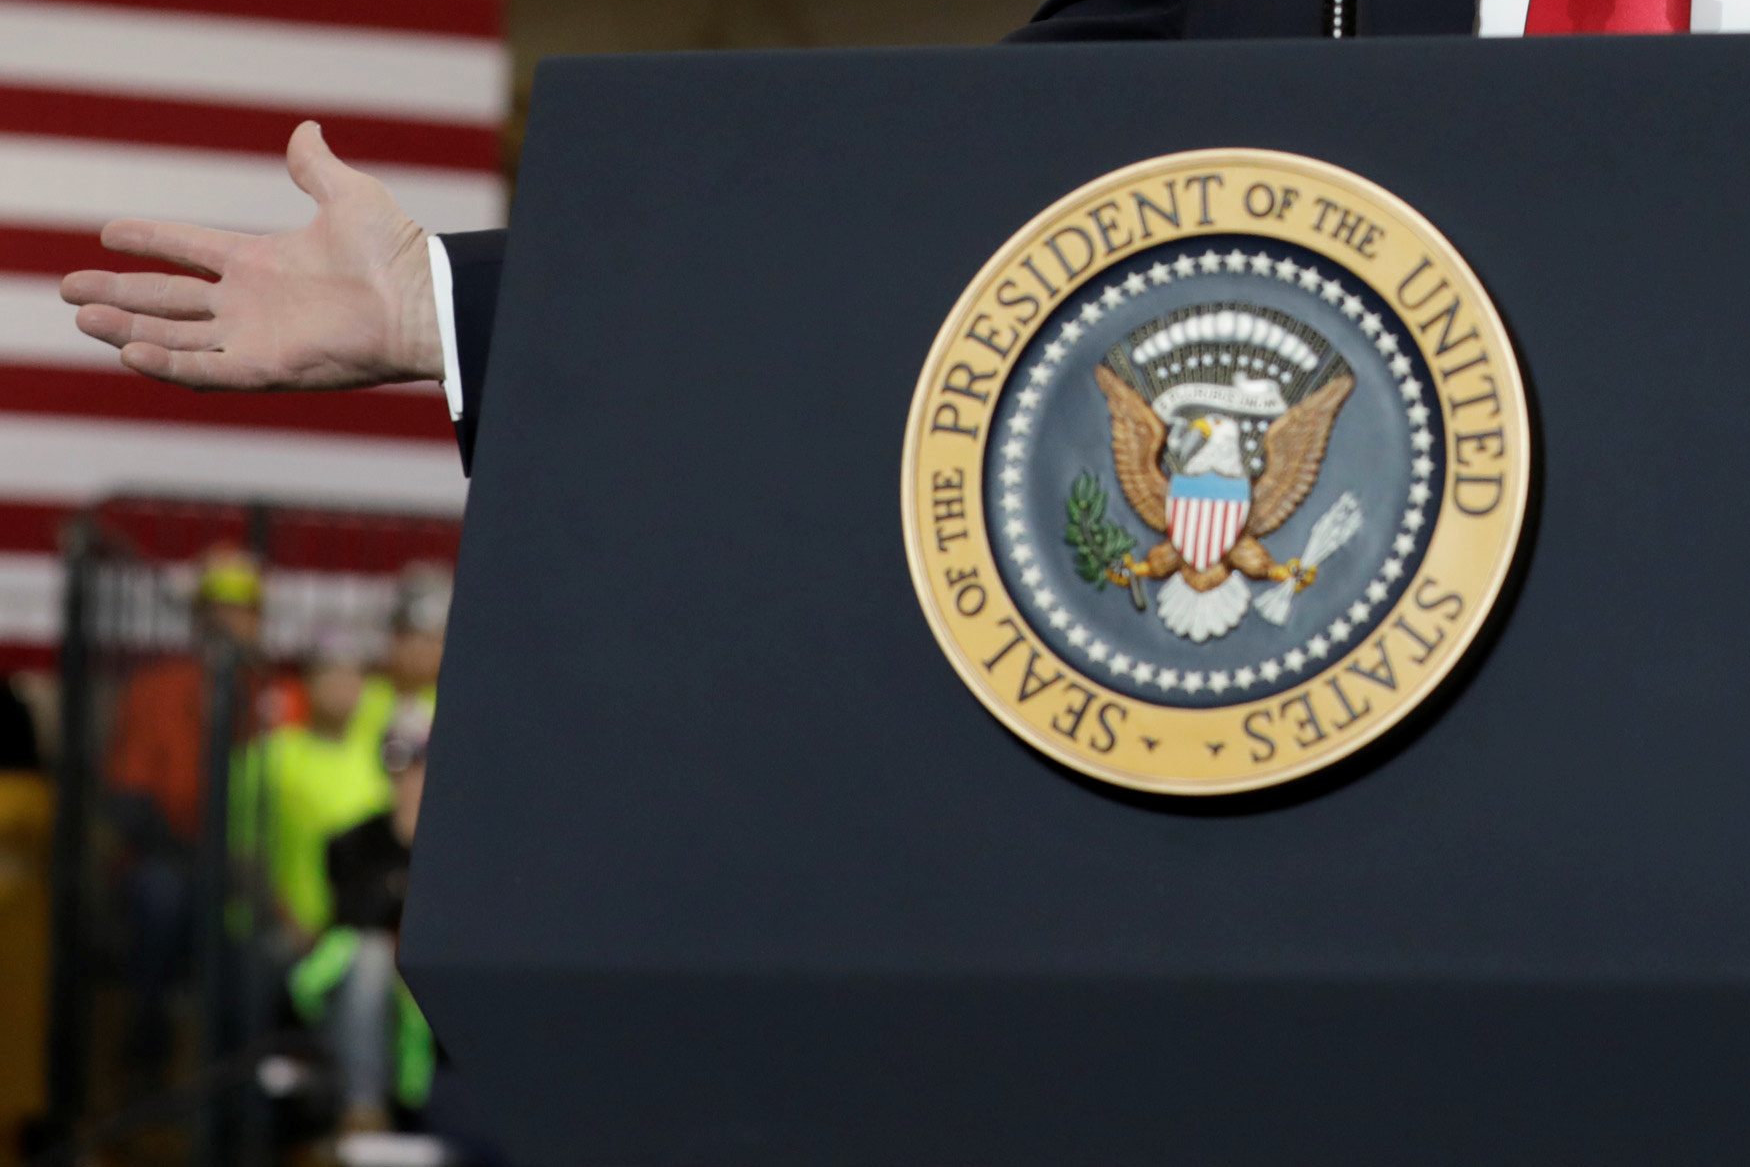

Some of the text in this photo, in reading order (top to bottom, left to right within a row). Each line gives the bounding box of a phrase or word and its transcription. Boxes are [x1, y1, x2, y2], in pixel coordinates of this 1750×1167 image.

[931, 173, 1505, 764] SEAL OF THE PRESIDENT OF THE UNITED STATES
